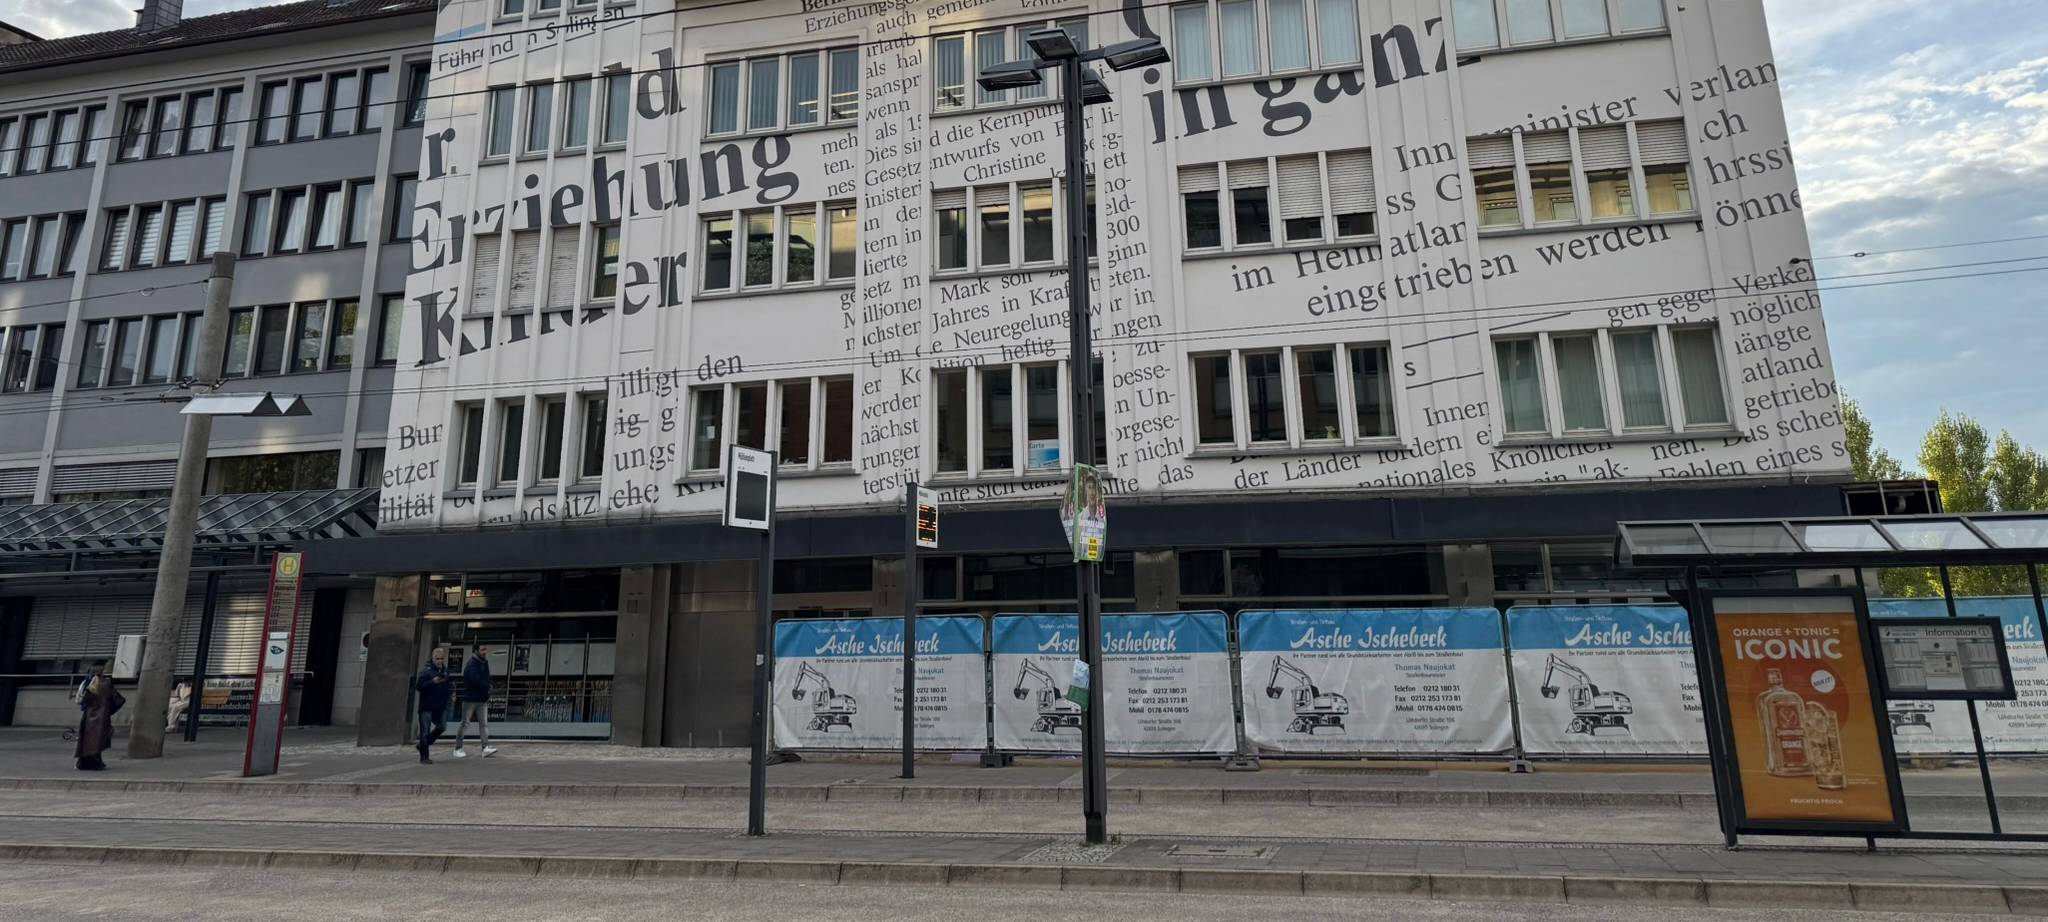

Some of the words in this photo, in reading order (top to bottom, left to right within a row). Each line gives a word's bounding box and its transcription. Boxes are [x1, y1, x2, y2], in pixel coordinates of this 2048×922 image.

[876, 11, 917, 34] auch
[875, 121, 898, 142] als
[824, 159, 855, 176] ten.
[947, 124, 974, 143] die
[827, 178, 856, 198] nes
[1010, 128, 1045, 149] von
[963, 150, 1047, 183] Christine
[406, 135, 800, 276] Erziehung
[1106, 214, 1141, 239] 300
[1107, 240, 1148, 268] ginn
[1535, 223, 1671, 267] werden
[941, 277, 991, 304] Mark
[1232, 264, 1275, 292] im
[1134, 287, 1155, 305] in
[932, 304, 990, 334] Jahres
[1002, 295, 1020, 313] in
[1607, 301, 1650, 328] gen
[1001, 336, 1057, 363] heftig
[697, 354, 744, 382] den
[1137, 387, 1177, 408] Un-
[1652, 438, 1706, 461] nen.
[1756, 443, 1823, 473] eines
[1158, 464, 1195, 487] das
[1234, 468, 1268, 490] der
[1282, 450, 1361, 482] Länder
[815, 633, 865, 655] Asche
[1290, 627, 1352, 649] Asche
[1564, 623, 1632, 646] Asche
[1733, 627, 1782, 637] ORANGE
[1794, 627, 1830, 636] TONIC
[1925, 627, 1977, 637] Information
[1735, 638, 1843, 660] ICONIC
[1395, 663, 1421, 671] Thomas
[1395, 704, 1413, 712] Mobil
